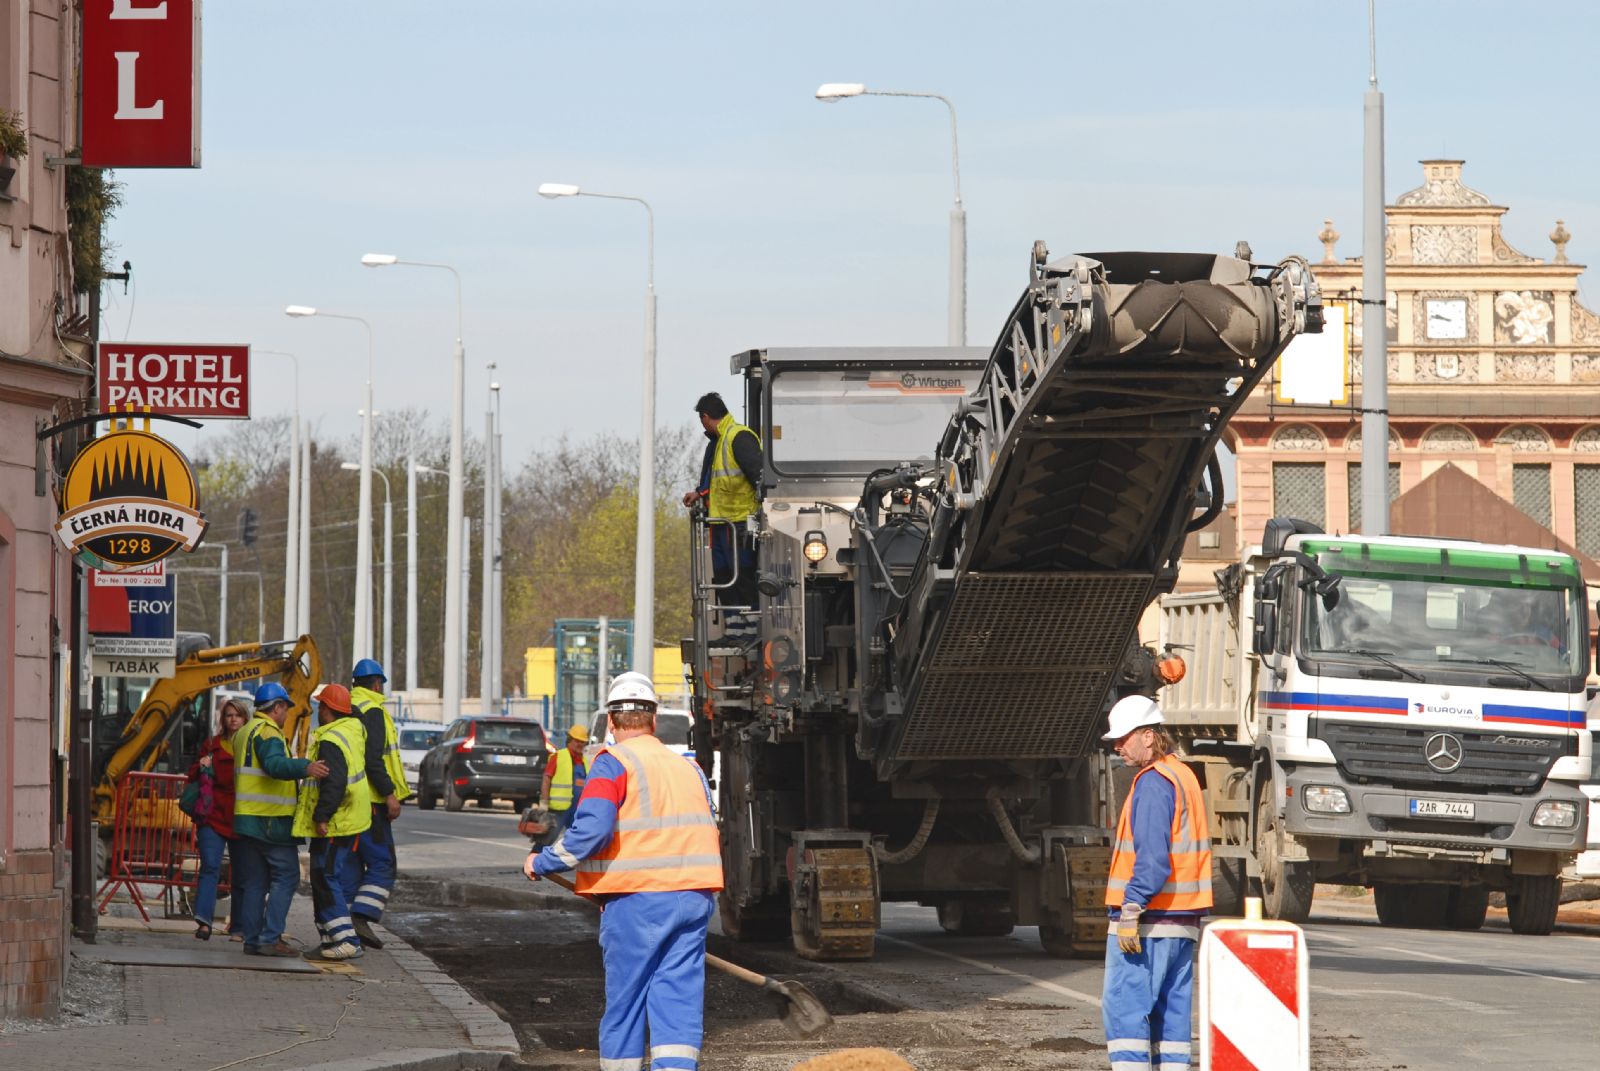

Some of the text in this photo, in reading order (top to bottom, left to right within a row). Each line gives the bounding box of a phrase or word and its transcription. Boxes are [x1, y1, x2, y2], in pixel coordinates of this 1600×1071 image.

[110, 0, 167, 119] L
[107, 353, 242, 383] HOTEL
[918, 378, 961, 389] Wirtgen
[108, 385, 241, 409] PARKING
[70, 505, 184, 535] ČERNÁ HORA
[108, 538, 151, 554] 1298
[128, 599, 173, 614] EROY
[107, 659, 160, 674] TABÁK
[208, 666, 260, 685] KOMATSU
[1427, 705, 1473, 715] EUROVIA
[1419, 802, 1469, 814] 2AR 7444
